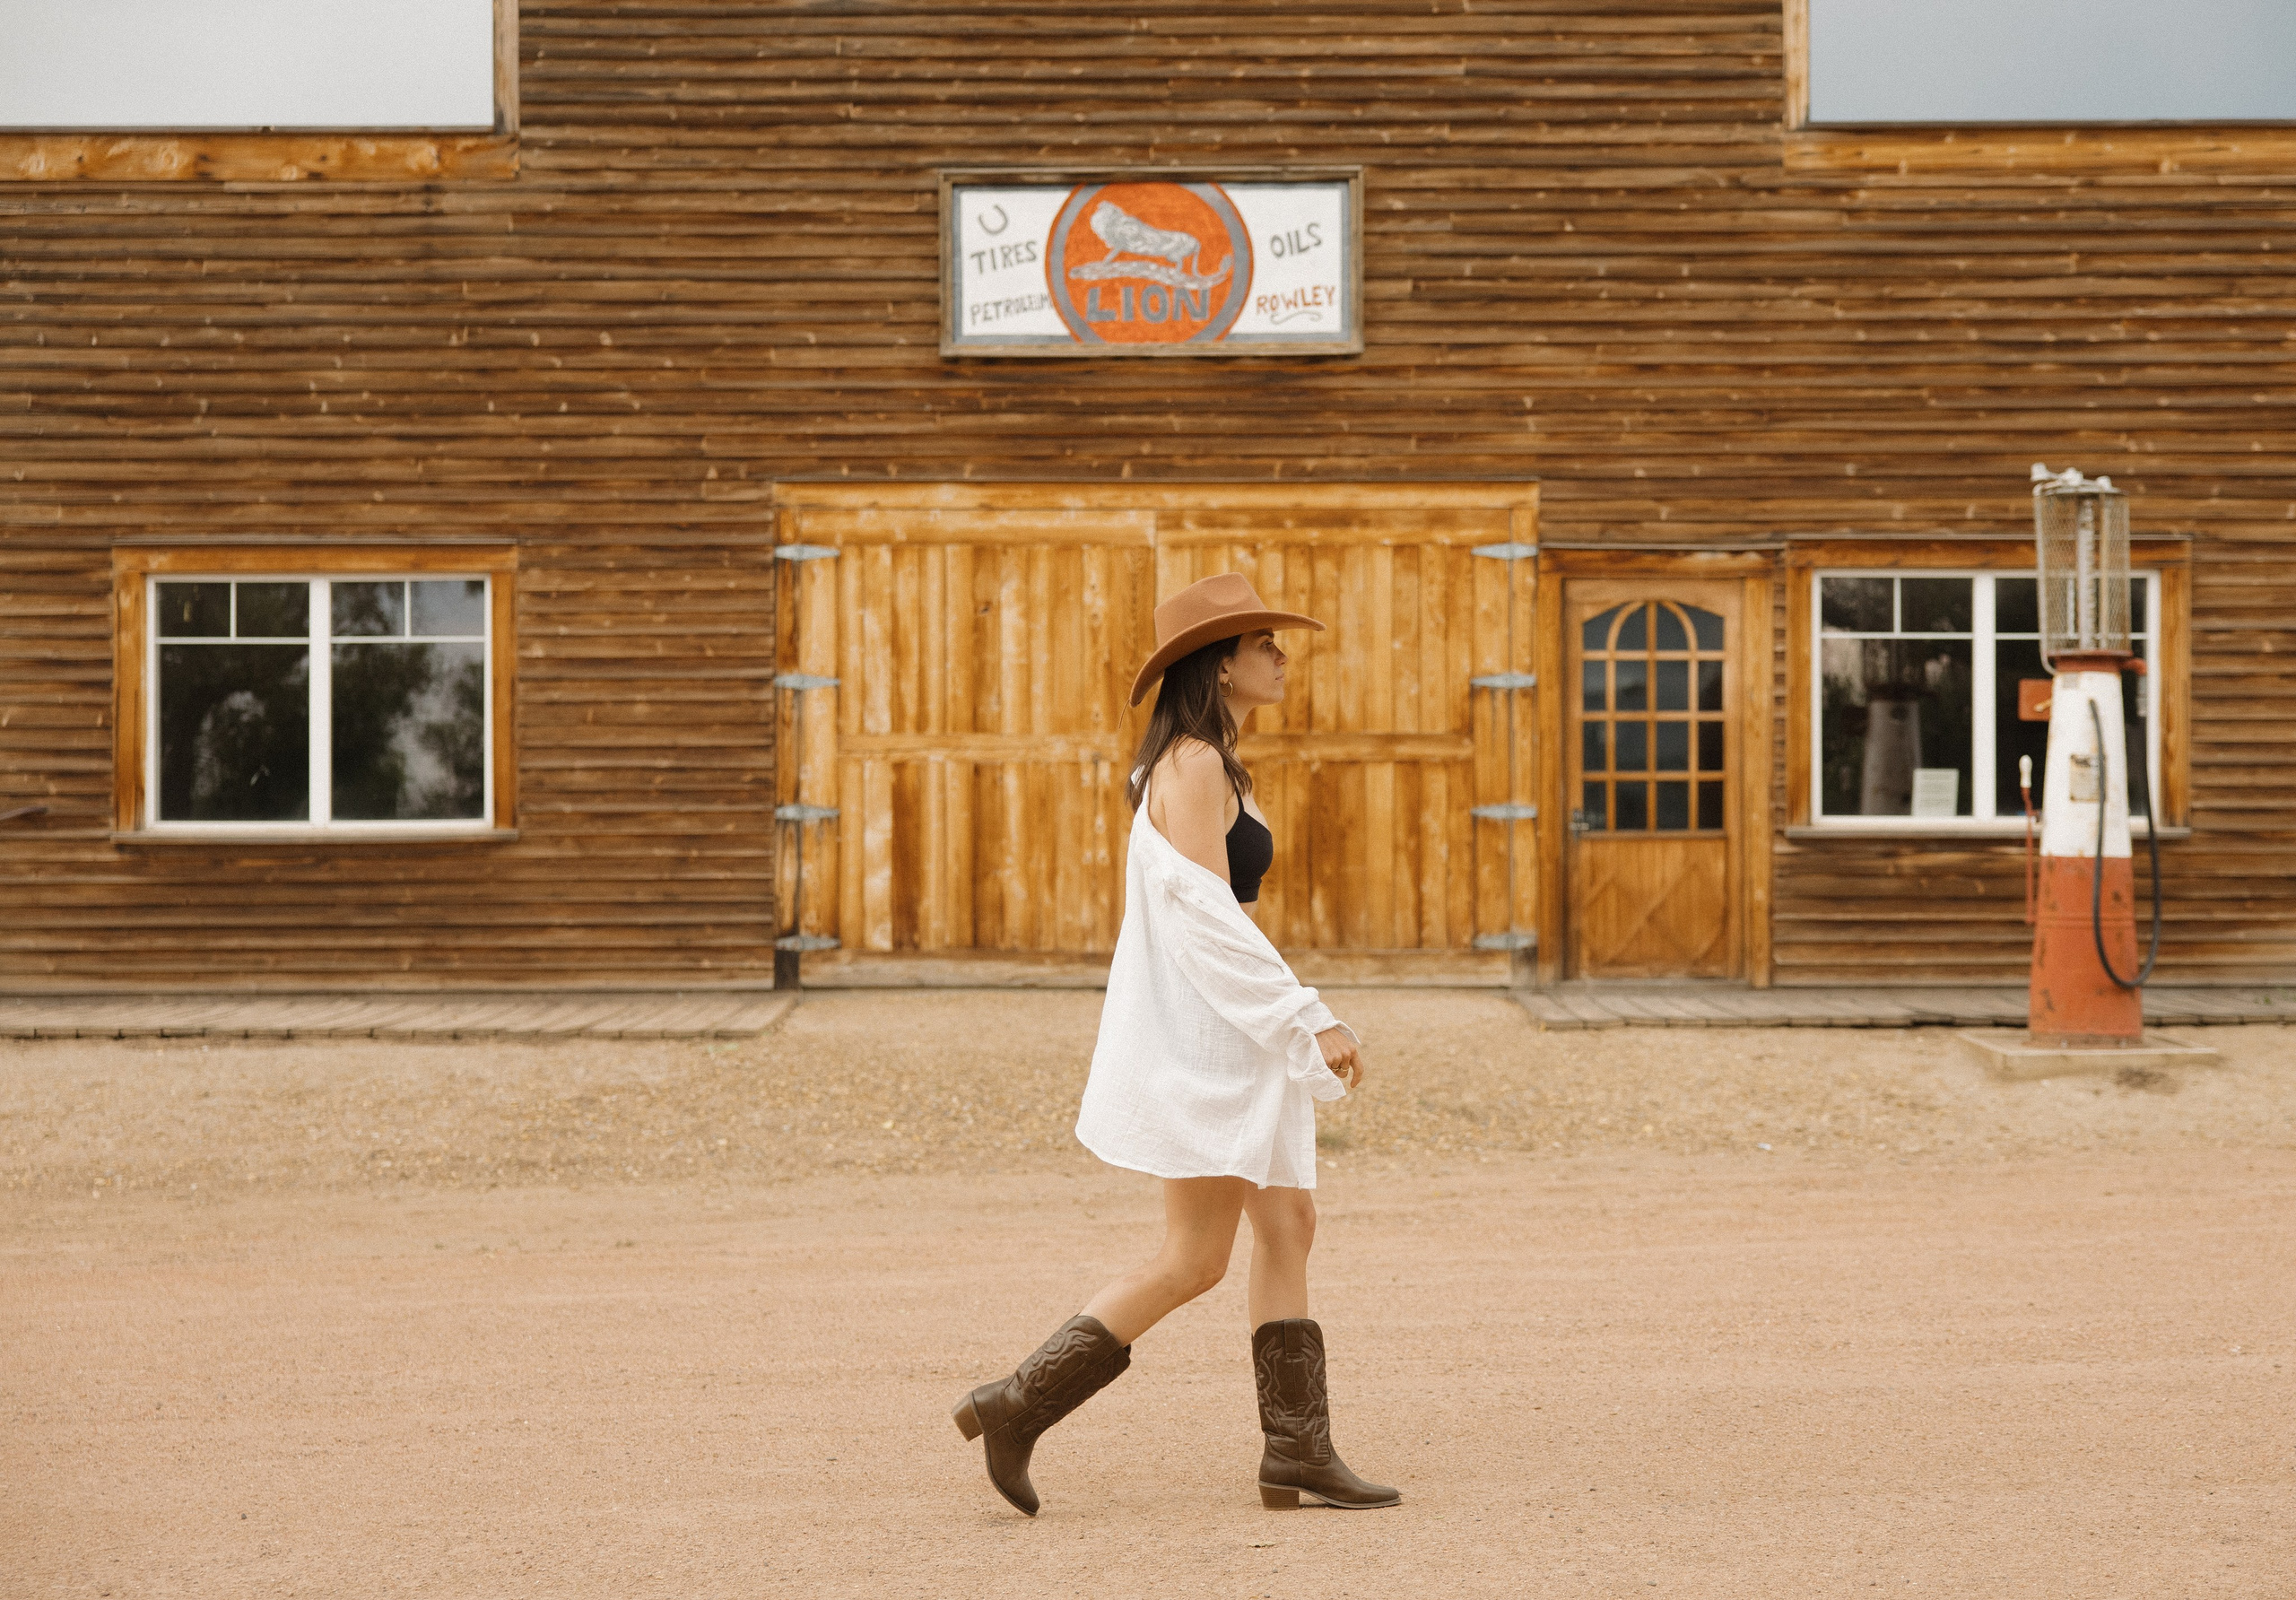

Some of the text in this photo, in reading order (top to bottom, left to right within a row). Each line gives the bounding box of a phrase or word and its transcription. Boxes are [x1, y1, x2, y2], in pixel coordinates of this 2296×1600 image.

[1270, 222, 1323, 257] OILS
[970, 240, 1037, 274] TIRES
[1086, 284, 1210, 324] LION
[1256, 284, 1335, 315] ROWLEY
